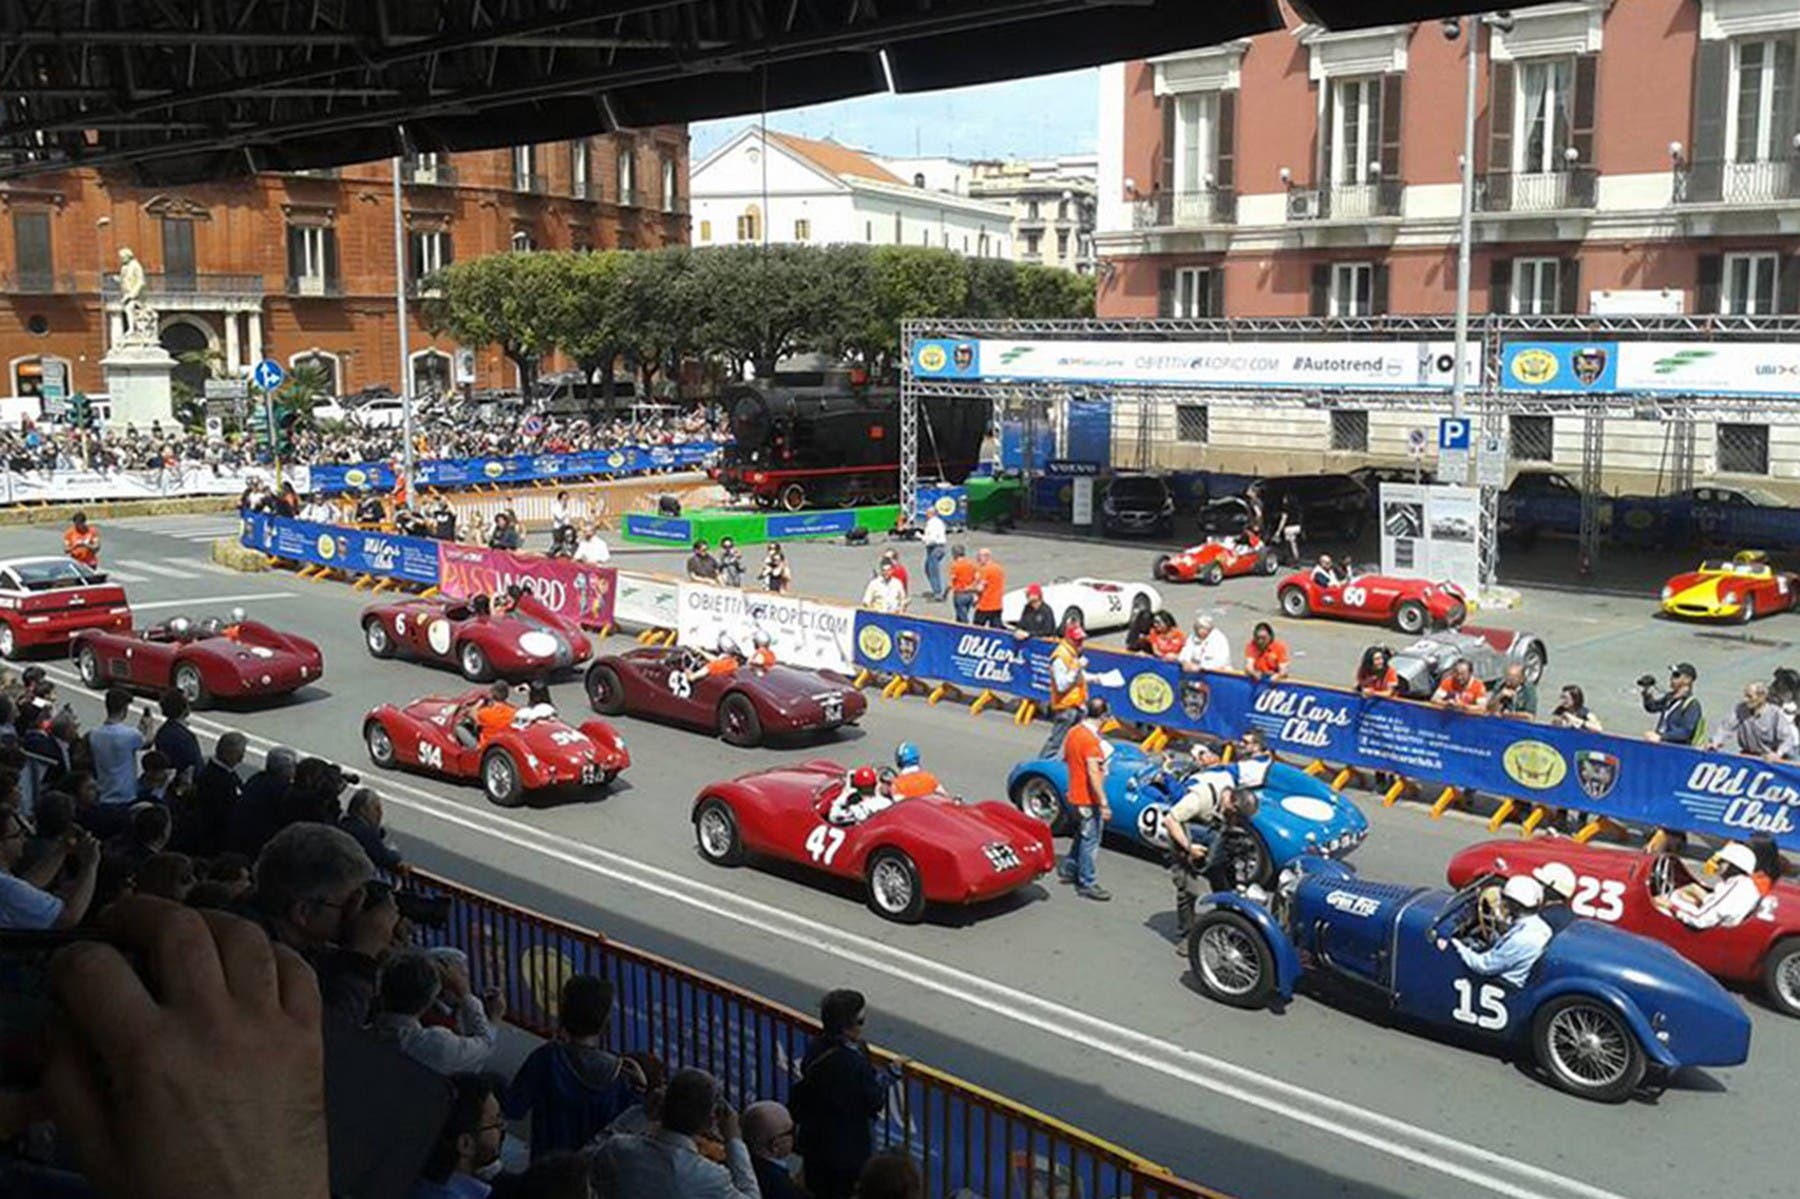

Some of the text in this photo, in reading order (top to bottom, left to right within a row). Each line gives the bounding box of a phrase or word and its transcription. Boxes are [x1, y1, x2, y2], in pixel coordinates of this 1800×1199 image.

[1293, 355, 1382, 371] #Autotrend
[1444, 420, 1464, 447] P
[1050, 462, 1097, 473] VOLVO
[1343, 587, 1367, 607] 60
[395, 613, 406, 636] 6
[958, 634, 1027, 664] Old Cars
[974, 659, 1014, 682] Club
[1254, 688, 1297, 716] Old
[1297, 695, 1352, 726] Cars
[1280, 718, 1333, 747] Club
[1687, 762, 1751, 796] Old
[1722, 798, 1795, 833] Club
[805, 824, 846, 866] 47
[1572, 874, 1626, 921] 23
[1452, 978, 1509, 1030] 15
